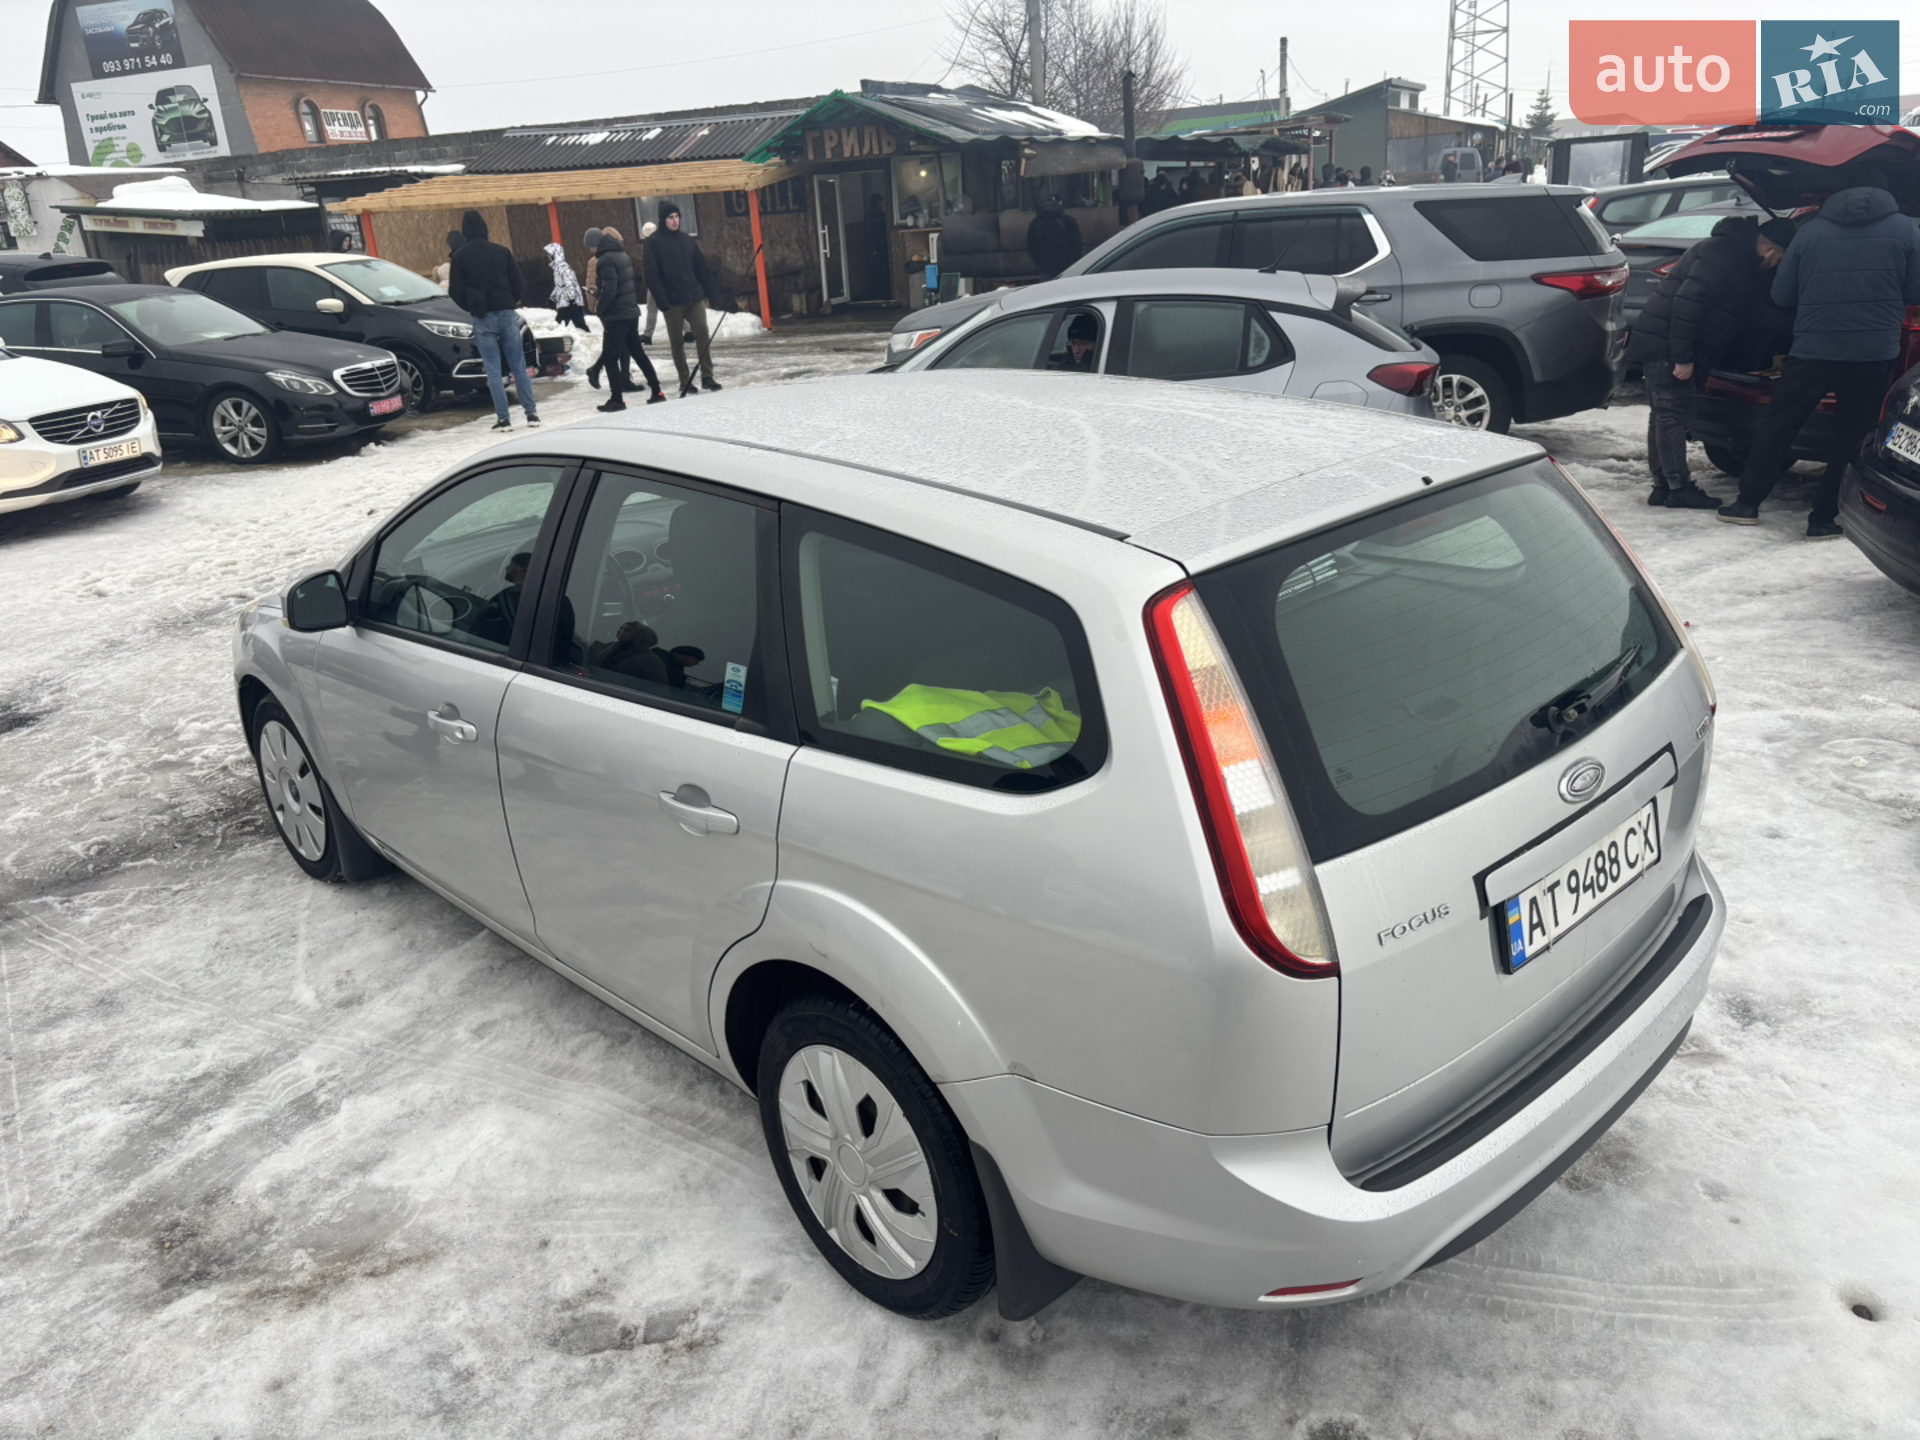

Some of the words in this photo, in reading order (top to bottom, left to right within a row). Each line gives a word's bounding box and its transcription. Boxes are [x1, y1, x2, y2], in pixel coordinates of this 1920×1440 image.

[102, 60, 122, 73] 093
[123, 57, 142, 71] 971
[144, 54, 158, 68] 54
[159, 52, 173, 65] 40
[86, 110, 109, 123] Гроші
[108, 111, 118, 119] на
[118, 109, 136, 118] авто
[323, 111, 363, 130] ОРЕНДА
[94, 122, 128, 135] пробігом
[805, 125, 897, 160] ГРИЛЬ
[732, 180, 800, 213] GILL
[89, 448, 101, 462] AT
[103, 445, 125, 460] 5095
[1529, 879, 1561, 947] AT
[1567, 840, 1621, 916] 9488
[1624, 813, 1655, 869] CX
[1377, 903, 1451, 947] FOCUS
[1511, 938, 1524, 956] UA
